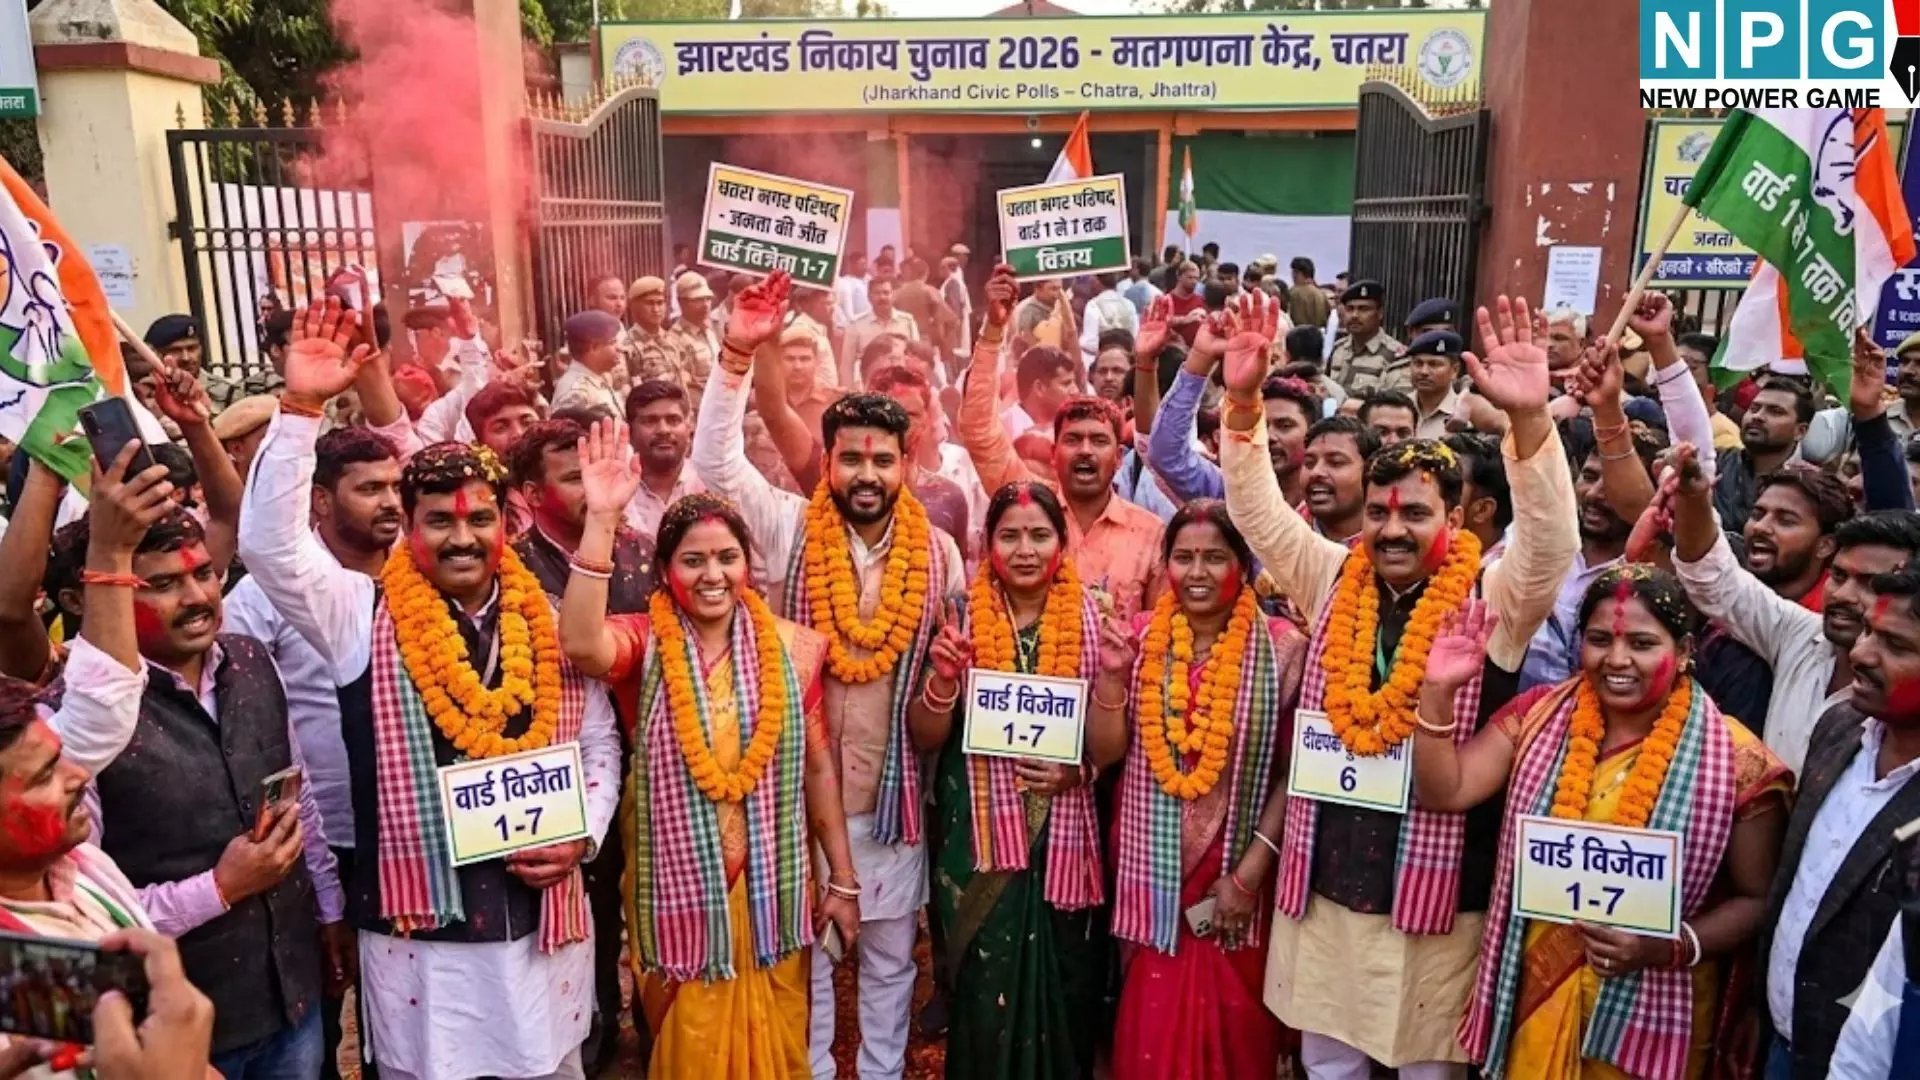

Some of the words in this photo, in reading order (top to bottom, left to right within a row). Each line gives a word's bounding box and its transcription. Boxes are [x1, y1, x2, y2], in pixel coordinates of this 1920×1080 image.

[674, 32, 791, 76] झारखंड
[798, 30, 899, 72] निकाय
[906, 38, 990, 82] चुनाव
[1000, 36, 1079, 71] 2026
[1111, 34, 1254, 69] मतगणना
[1331, 33, 1408, 66] चतरा
[863, 84, 961, 103] (Jharkhand
[967, 84, 1010, 101] Civic
[1015, 83, 1059, 99] Polls
[1081, 82, 1143, 101] Chatra,
[1082, 216, 1107, 233] तक
[1741, 160, 1797, 212] वार्ड
[1781, 199, 1800, 228] 1
[1801, 252, 1847, 304] तक
[711, 238, 744, 264] वार्ड
[801, 257, 829, 280] 1-7
[1035, 247, 1093, 272] विजय
[977, 683, 1012, 712] वार्ड
[1017, 685, 1076, 719] विजेता
[1003, 722, 1046, 748] 1-7
[453, 770, 495, 810] वार्ड
[501, 762, 571, 802] विजेता
[1340, 766, 1357, 792] 6
[494, 807, 543, 842] 1-7
[1529, 834, 1575, 869] वार्ड
[1582, 836, 1667, 880] विजेता
[1566, 882, 1625, 916] 1-7
